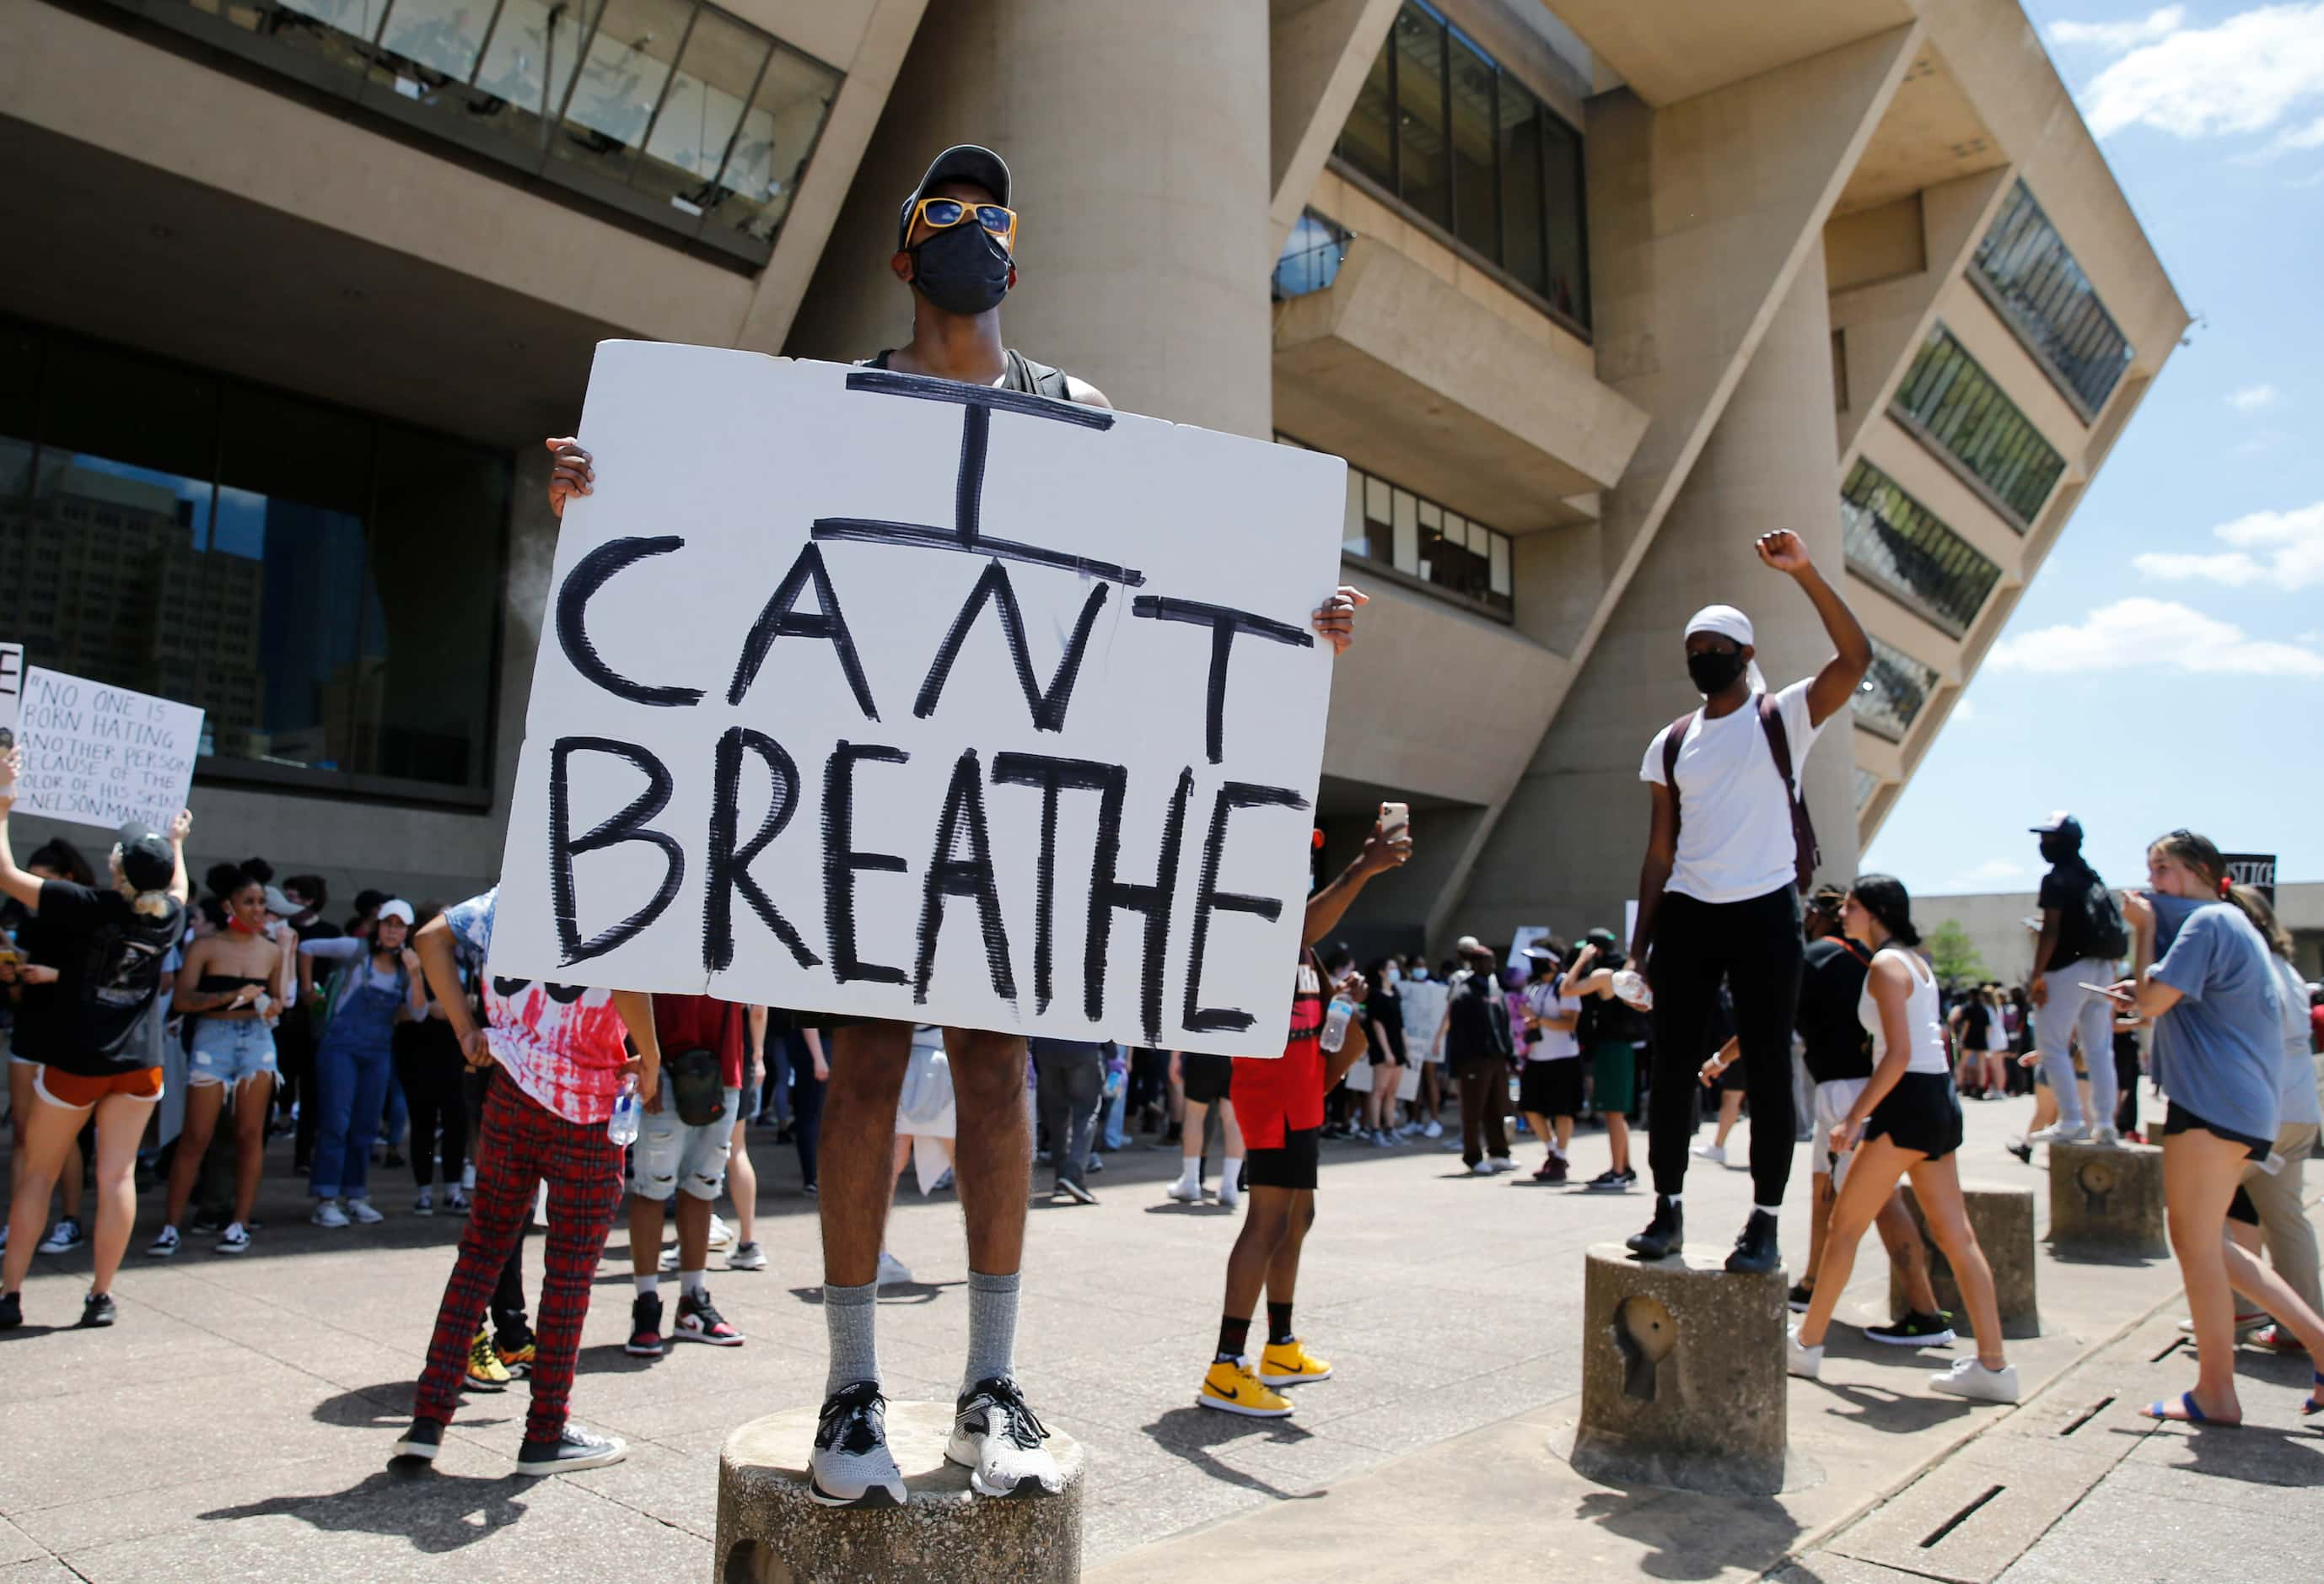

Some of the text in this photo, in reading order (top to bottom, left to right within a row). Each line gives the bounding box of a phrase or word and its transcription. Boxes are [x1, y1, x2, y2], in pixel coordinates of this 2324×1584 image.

[811, 373, 1148, 589] I
[93, 690, 137, 717] ONE
[147, 703, 165, 722] IS
[23, 703, 175, 750] BORN HATING
[19, 730, 192, 773] ANOTHER PERSON
[19, 774, 63, 789] OLOR
[71, 777, 94, 791] OF
[100, 782, 132, 799] HIS
[110, 766, 131, 781] OF
[142, 770, 177, 789] THE
[106, 802, 175, 830] MANDEL
[548, 727, 1311, 1048] BREATHE
[2226, 862, 2275, 887] STICE
